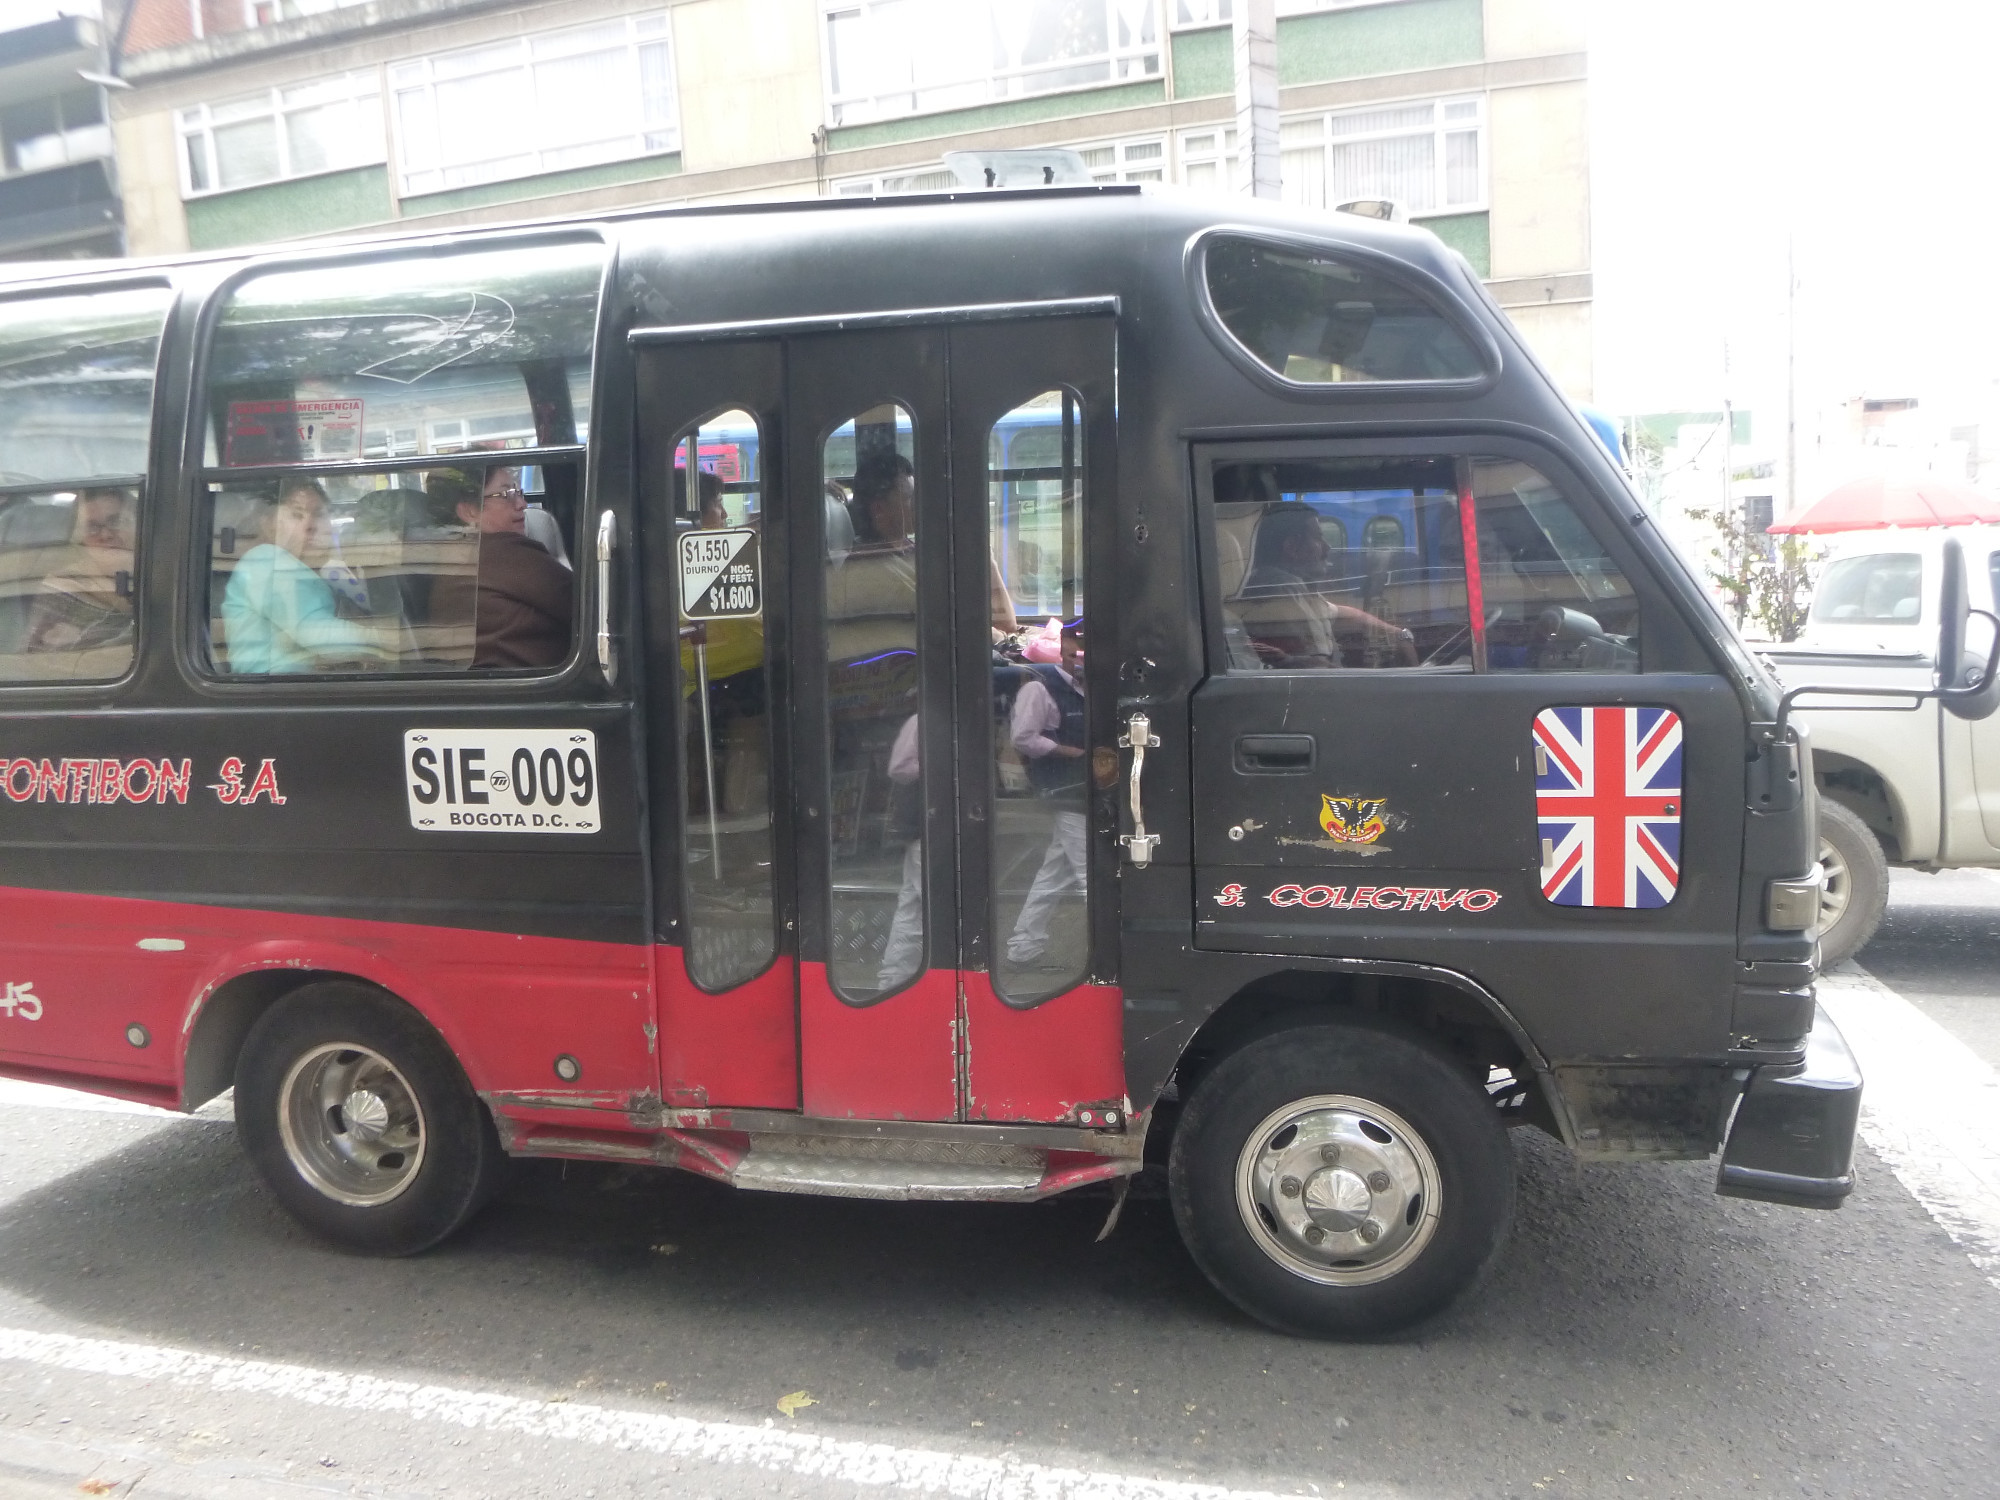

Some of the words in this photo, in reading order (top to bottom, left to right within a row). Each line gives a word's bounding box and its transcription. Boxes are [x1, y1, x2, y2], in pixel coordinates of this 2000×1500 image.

[292, 402, 360, 412] EMERGENCIA
[685, 539, 729, 563] $1.550
[686, 565, 720, 575] DIURNO
[721, 574, 728, 584] Y
[730, 573, 754, 583] FEST.
[730, 564, 754, 574] NOC.
[710, 585, 754, 613] $1.600
[206, 757, 287, 805] S.A.
[411, 747, 490, 805] SIE
[511, 747, 594, 807] 009
[449, 812, 527, 826] BOGOTA
[532, 813, 569, 827] D.C.
[1213, 883, 1247, 907] S.
[1263, 885, 1502, 912] COLECTIVO
